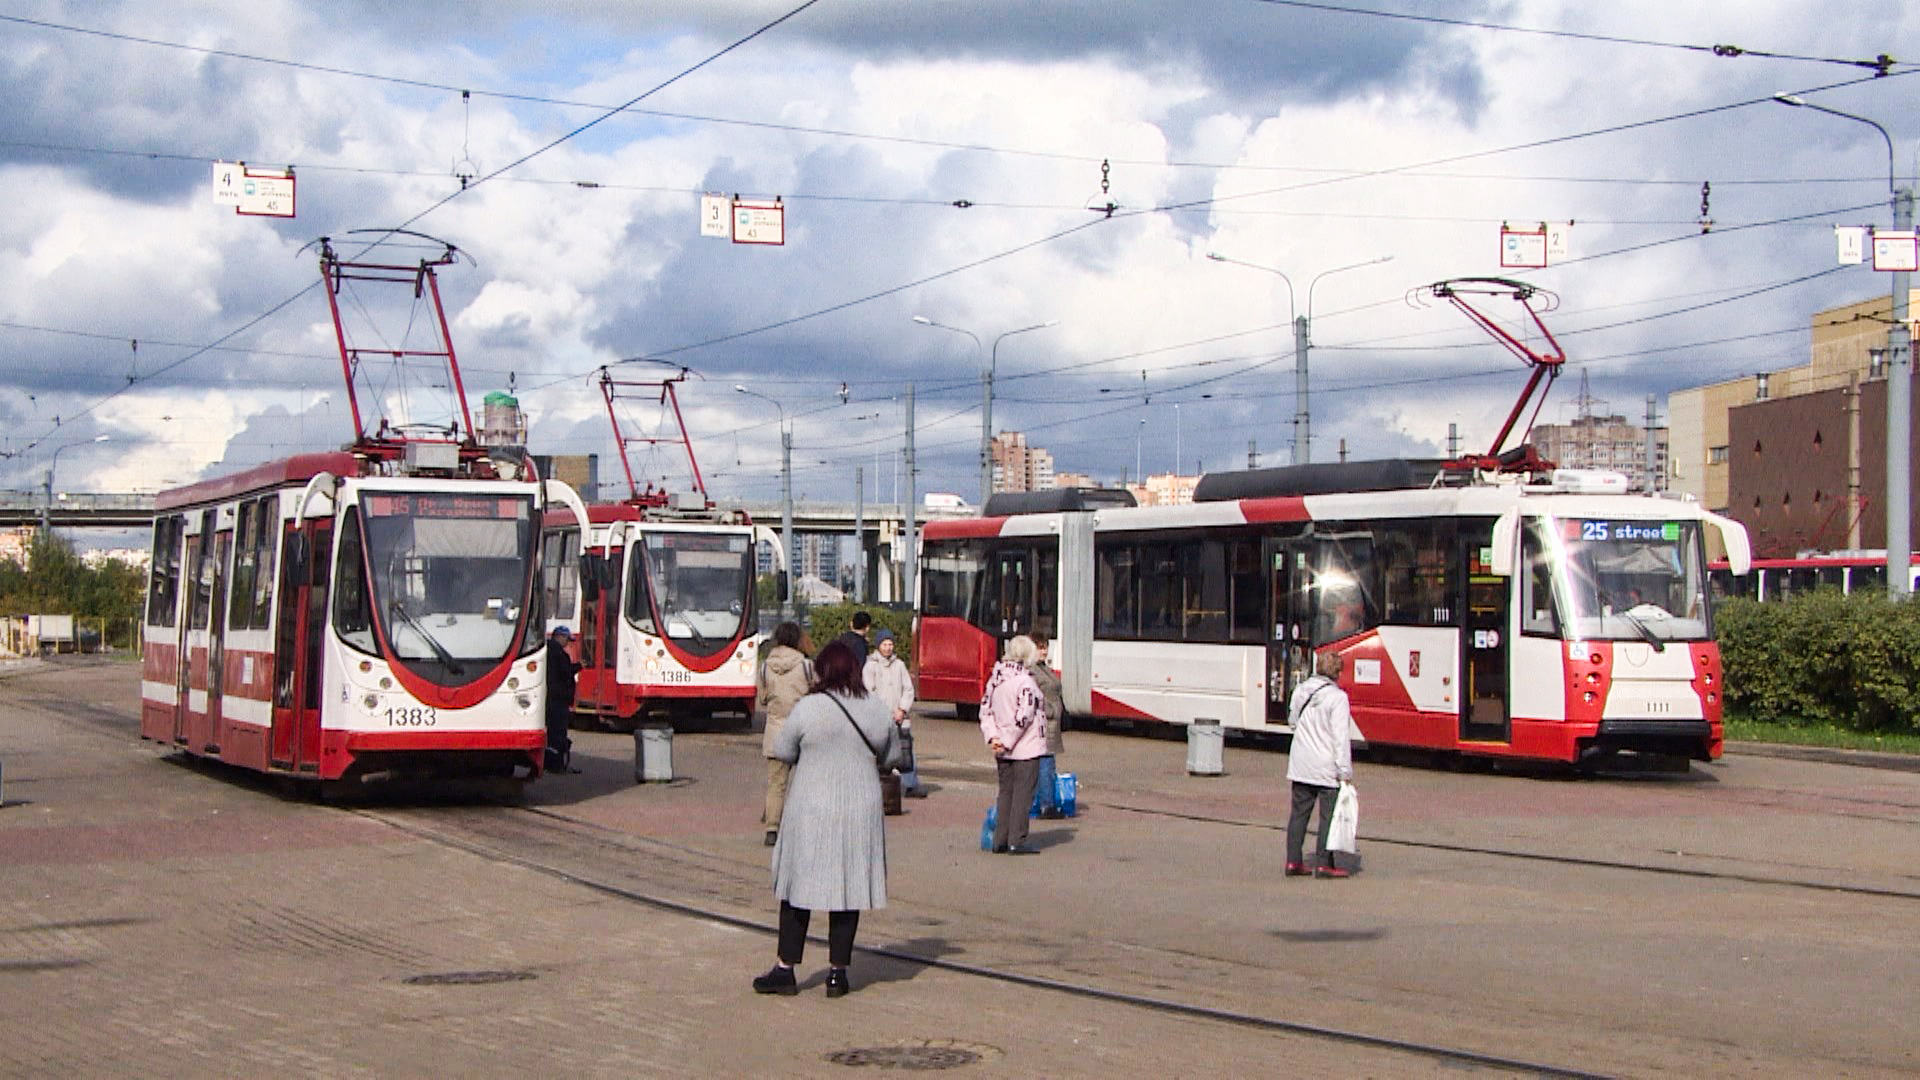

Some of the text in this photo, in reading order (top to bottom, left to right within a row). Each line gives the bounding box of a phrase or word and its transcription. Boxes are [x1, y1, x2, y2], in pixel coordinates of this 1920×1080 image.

[223, 171, 231, 187] 4
[712, 205, 719, 220] 3
[1552, 232, 1560, 246] 2
[1583, 521, 1609, 541] 25
[1433, 607, 1450, 622] 1111
[660, 671, 692, 682] 1386
[1647, 702, 1669, 712] 1111
[384, 706, 436, 726] 1383
